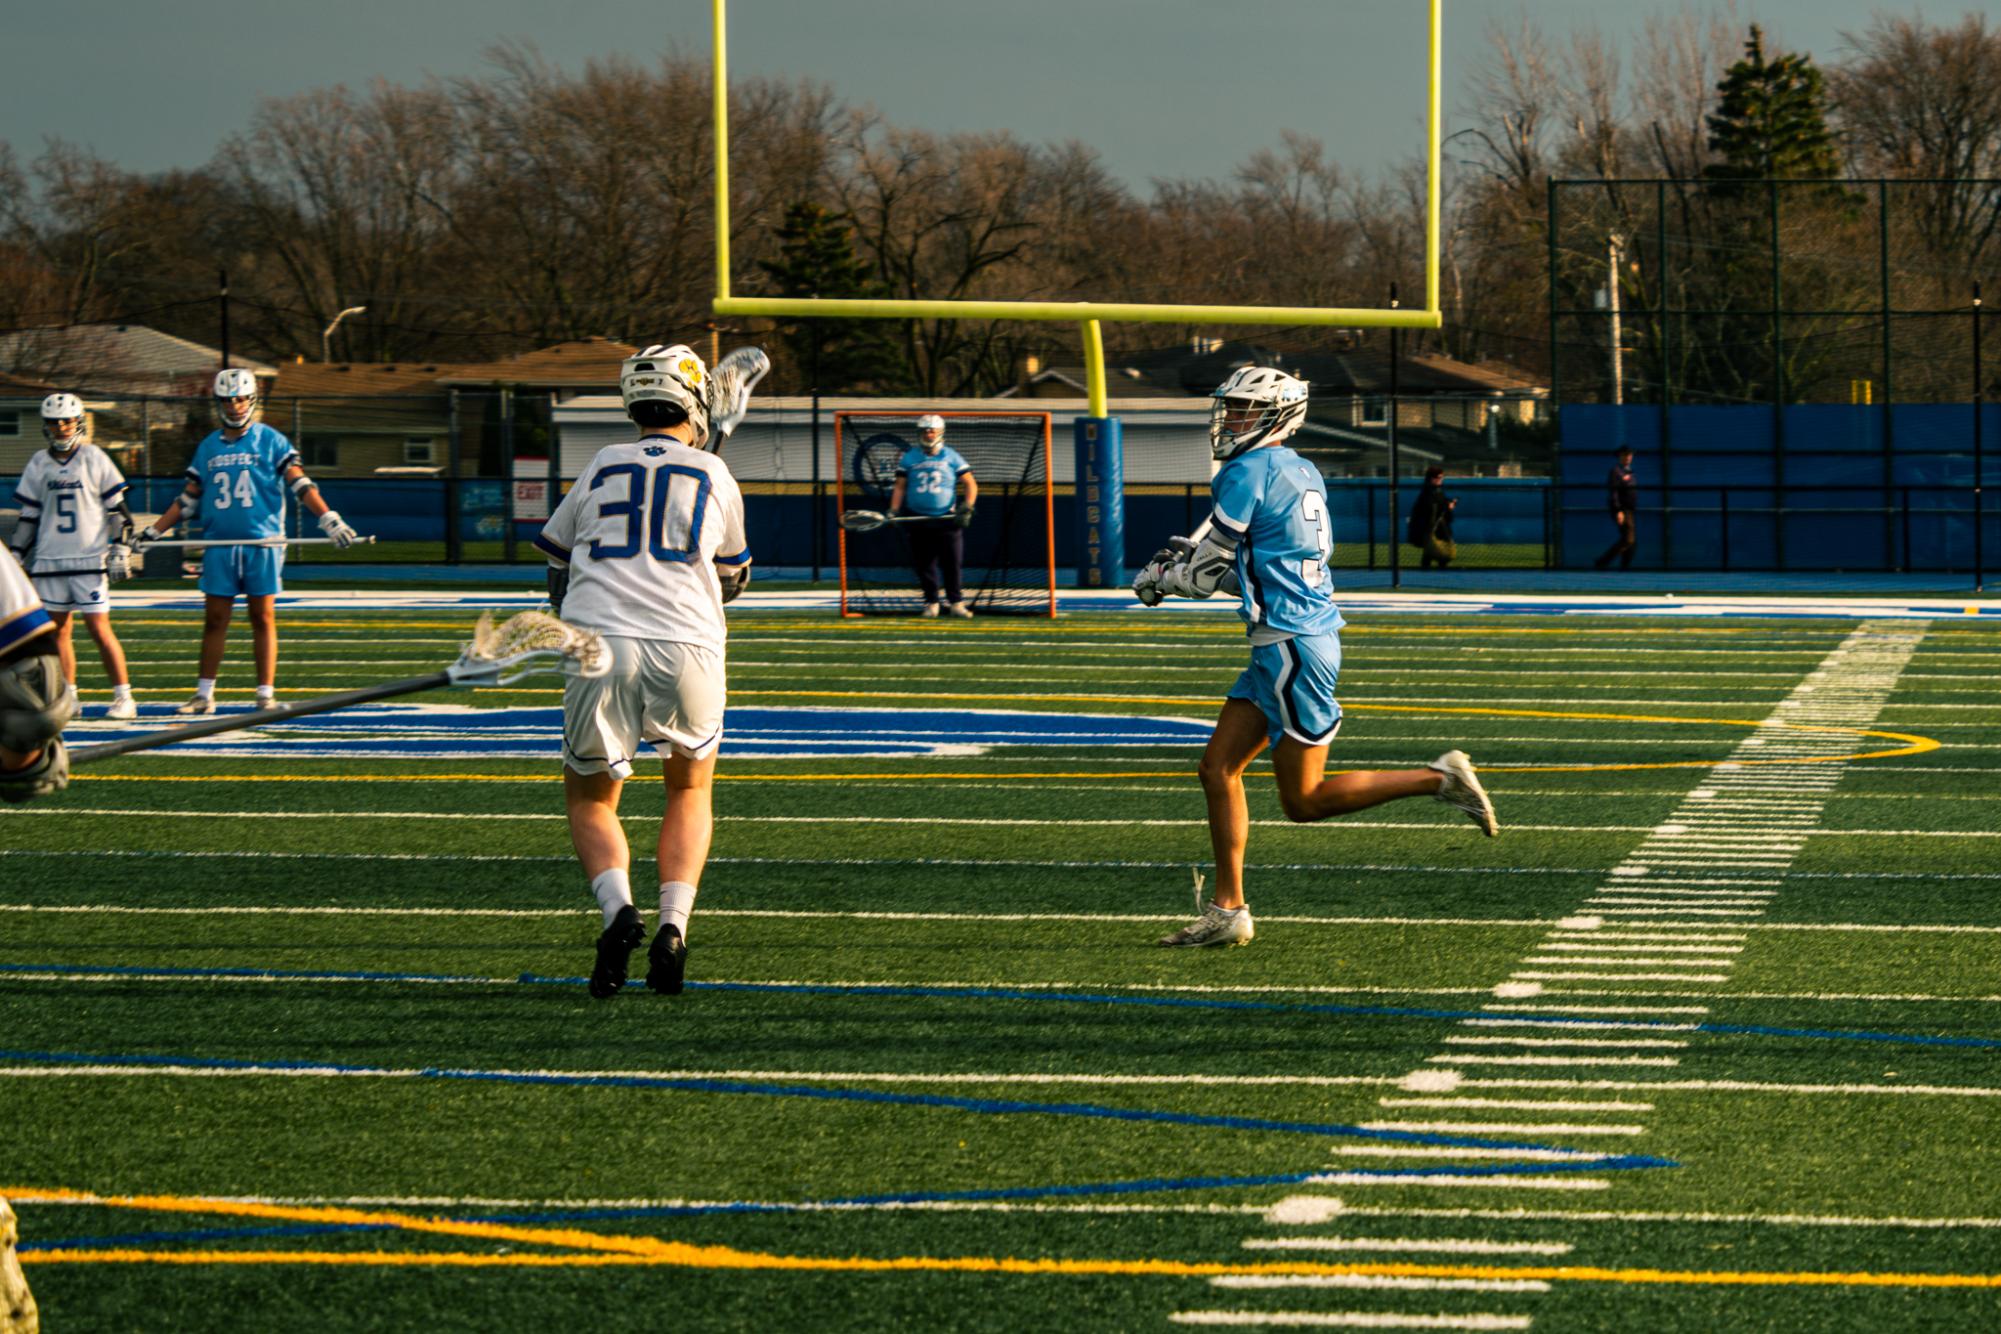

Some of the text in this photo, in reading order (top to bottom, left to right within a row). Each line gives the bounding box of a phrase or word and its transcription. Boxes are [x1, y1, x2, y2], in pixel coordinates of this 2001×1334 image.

[213, 470, 257, 509] 34
[916, 471, 944, 494] 32
[57, 494, 77, 534] 5
[588, 463, 713, 564] 30
[1301, 489, 1334, 588] 3
